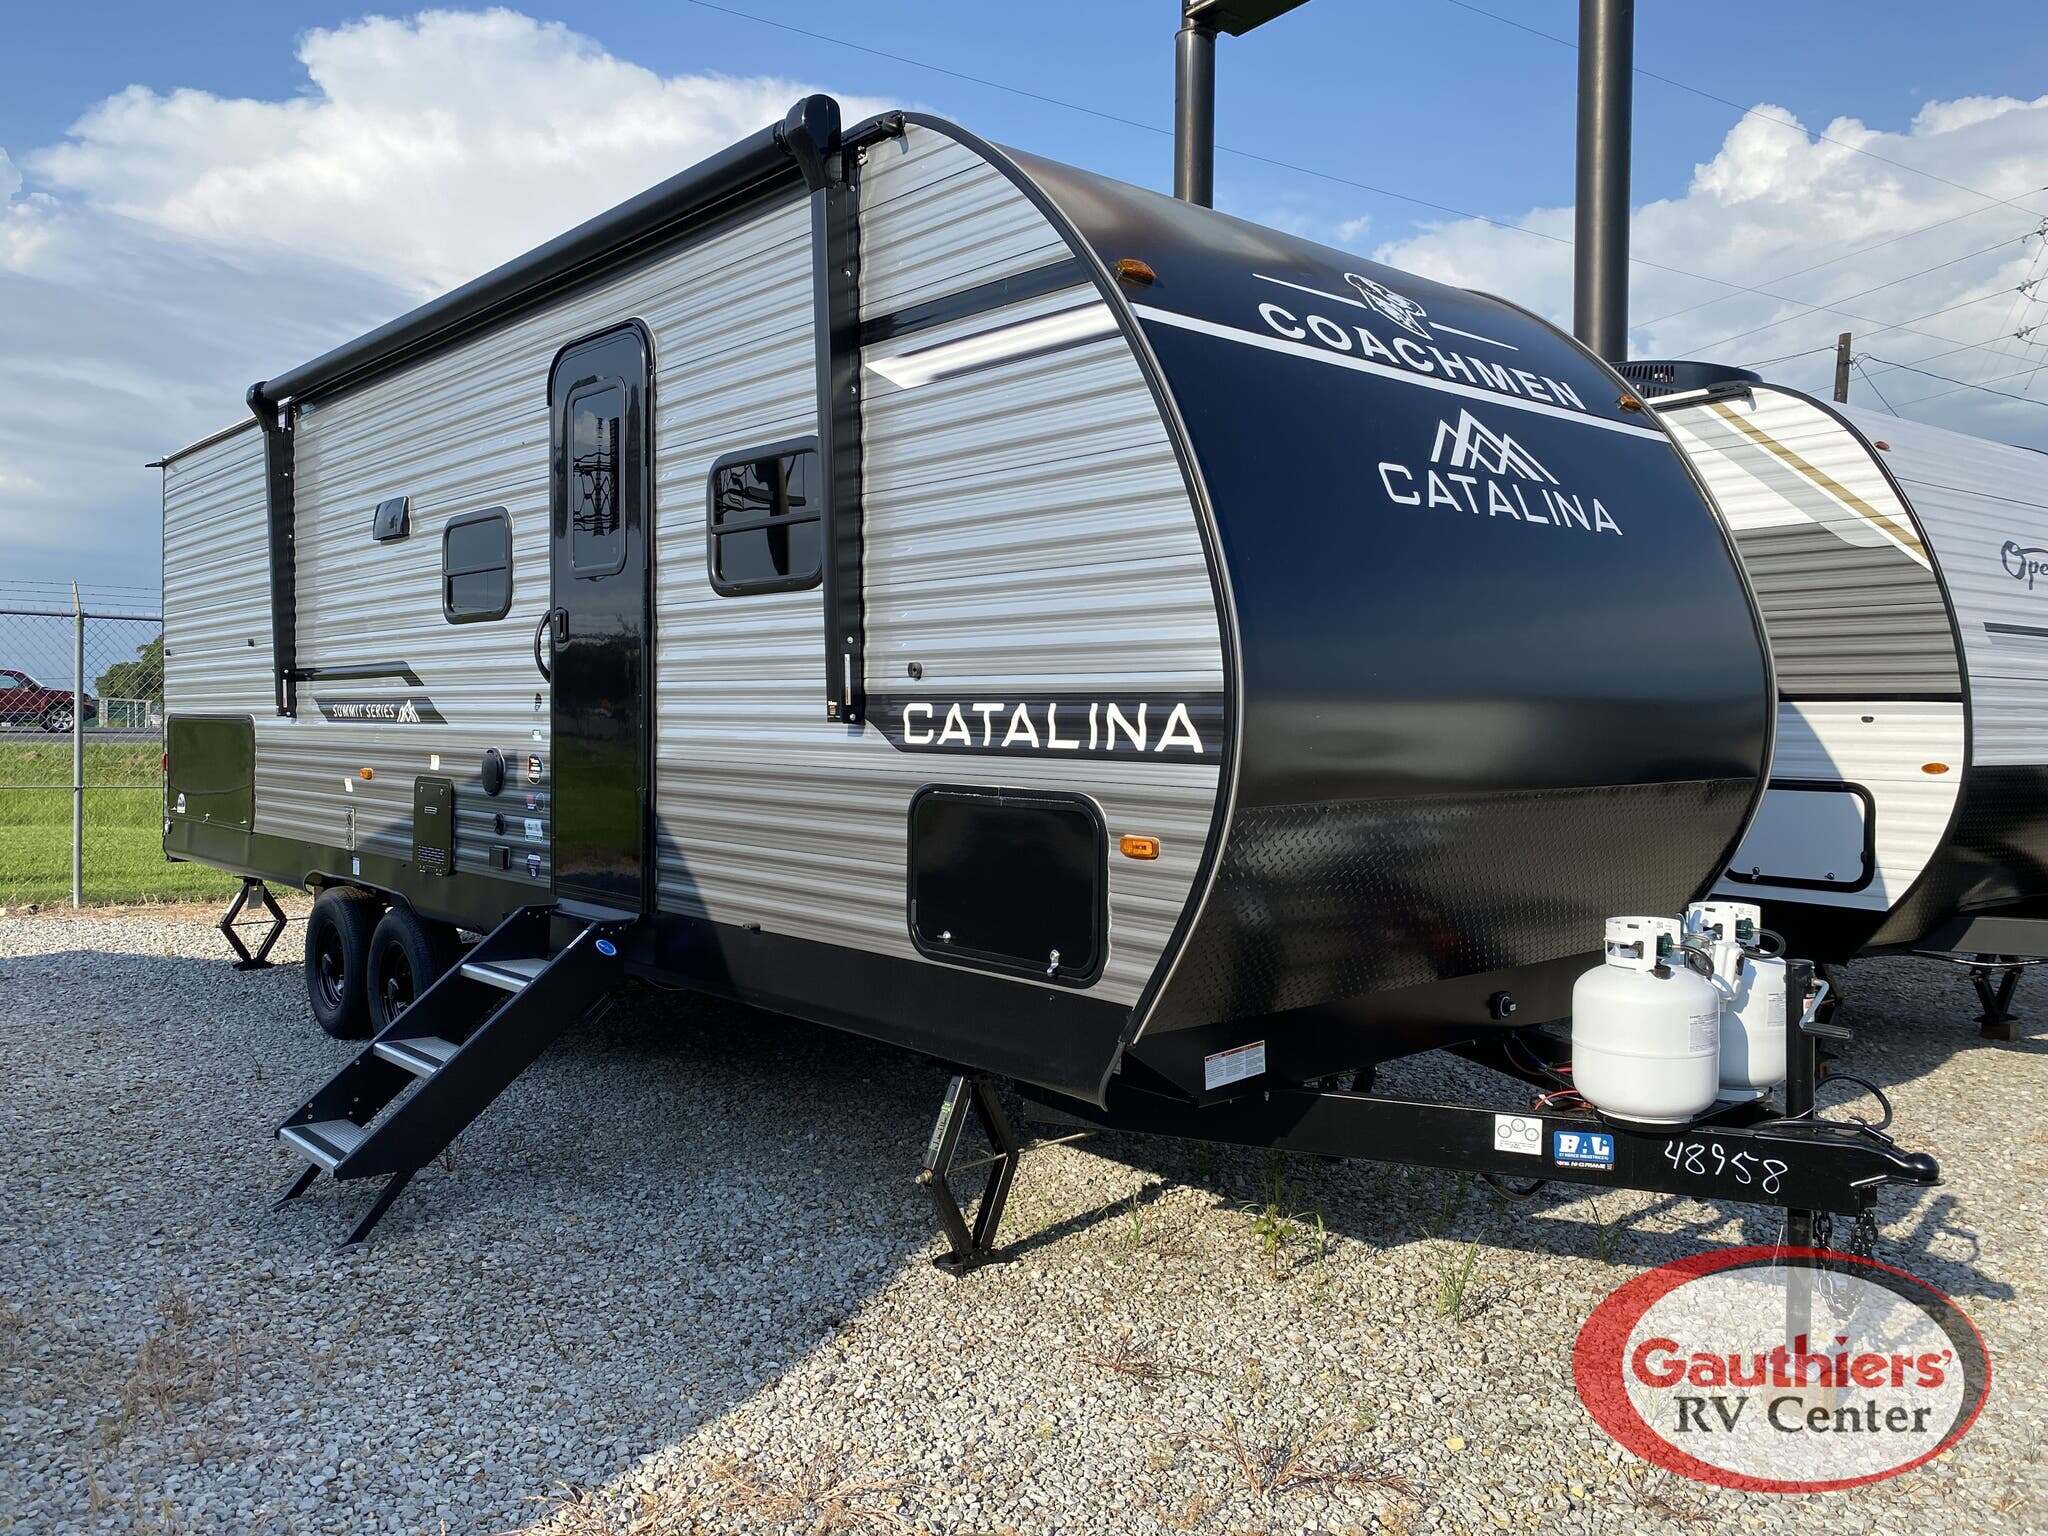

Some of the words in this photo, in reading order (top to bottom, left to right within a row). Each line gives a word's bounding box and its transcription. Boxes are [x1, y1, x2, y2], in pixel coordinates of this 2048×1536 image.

[1258, 303, 1586, 410] COACHMEN
[1378, 462, 1623, 536] CATALINA
[332, 703, 363, 718] SUMMIT
[365, 703, 395, 718] SERIES
[903, 702, 1204, 754] CATALINA
[1664, 1140, 1788, 1194] 48958
